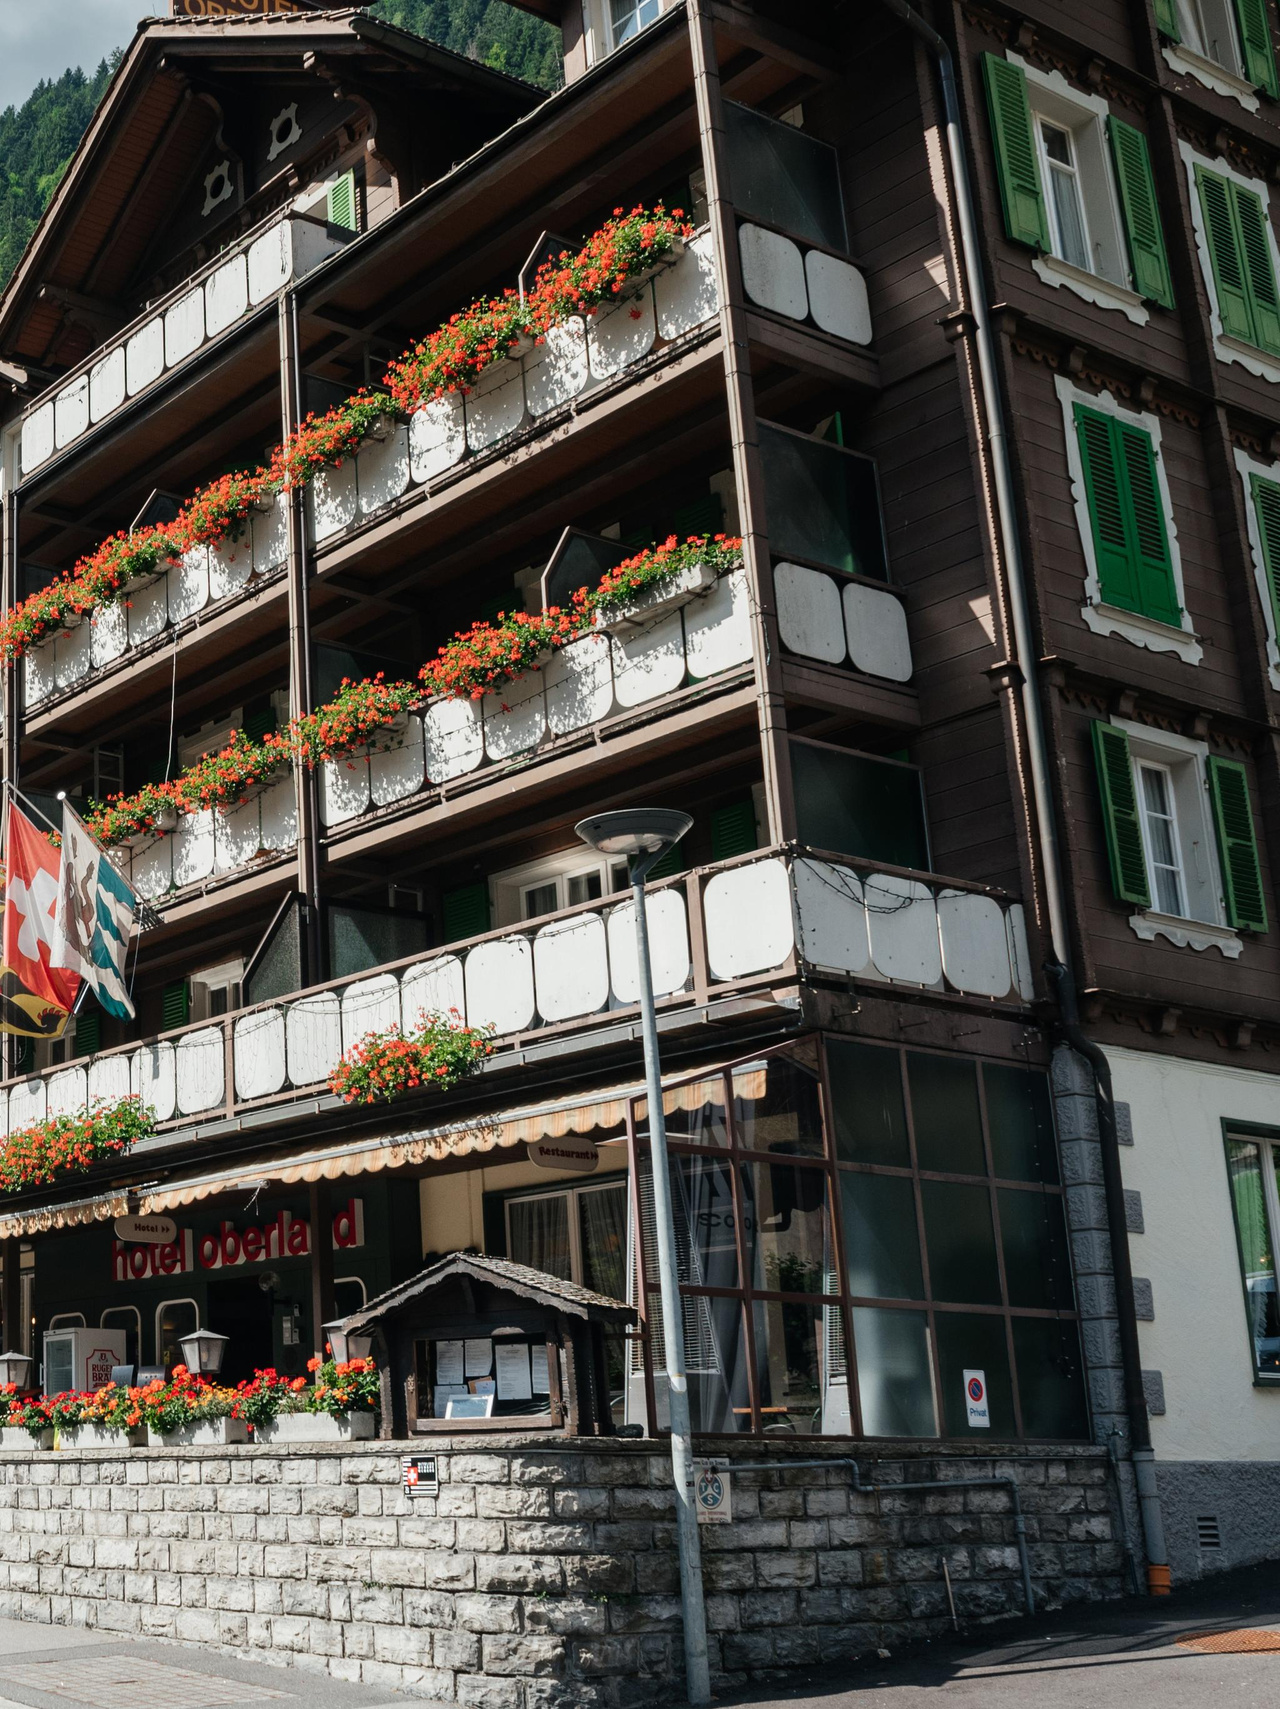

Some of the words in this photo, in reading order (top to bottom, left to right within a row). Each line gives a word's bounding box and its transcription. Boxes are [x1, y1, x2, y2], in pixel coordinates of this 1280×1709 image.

[538, 1146, 590, 1160] Restaurant
[134, 1223, 158, 1233] Hotel
[112, 1228, 190, 1281] hotel
[198, 1198, 362, 1270] oberlad
[970, 1407, 987, 1417] Privat
